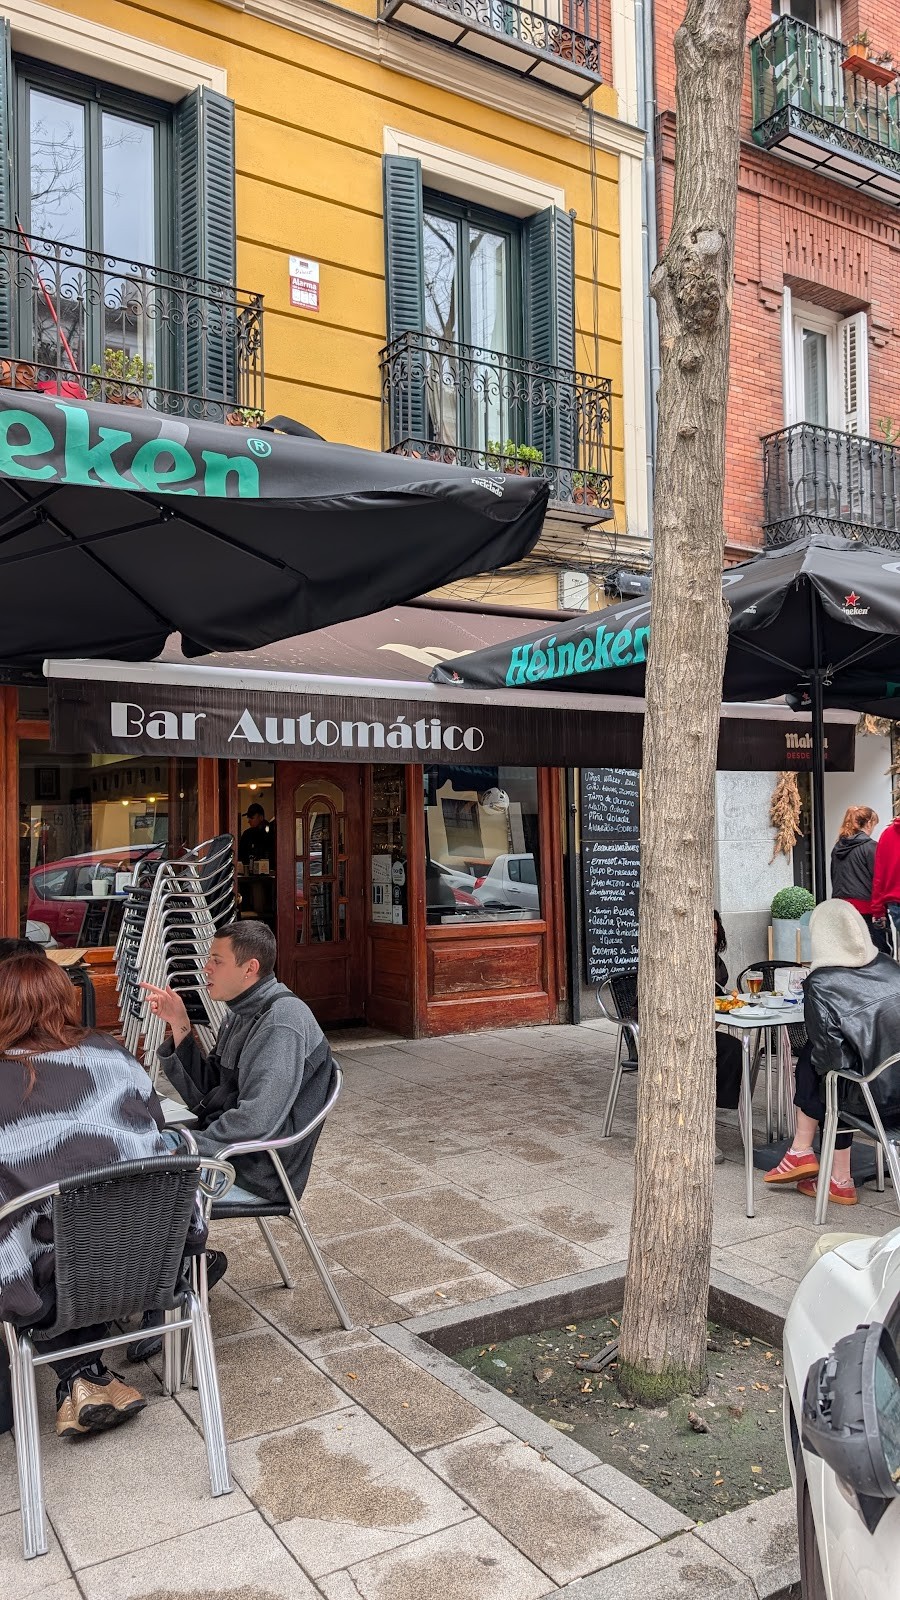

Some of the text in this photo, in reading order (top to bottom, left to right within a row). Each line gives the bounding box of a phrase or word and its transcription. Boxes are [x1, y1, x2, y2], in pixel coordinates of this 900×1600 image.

[292, 278, 317, 290] Alarma
[110, 701, 485, 752] Bar Automático
[785, 732, 829, 749] Mahu
